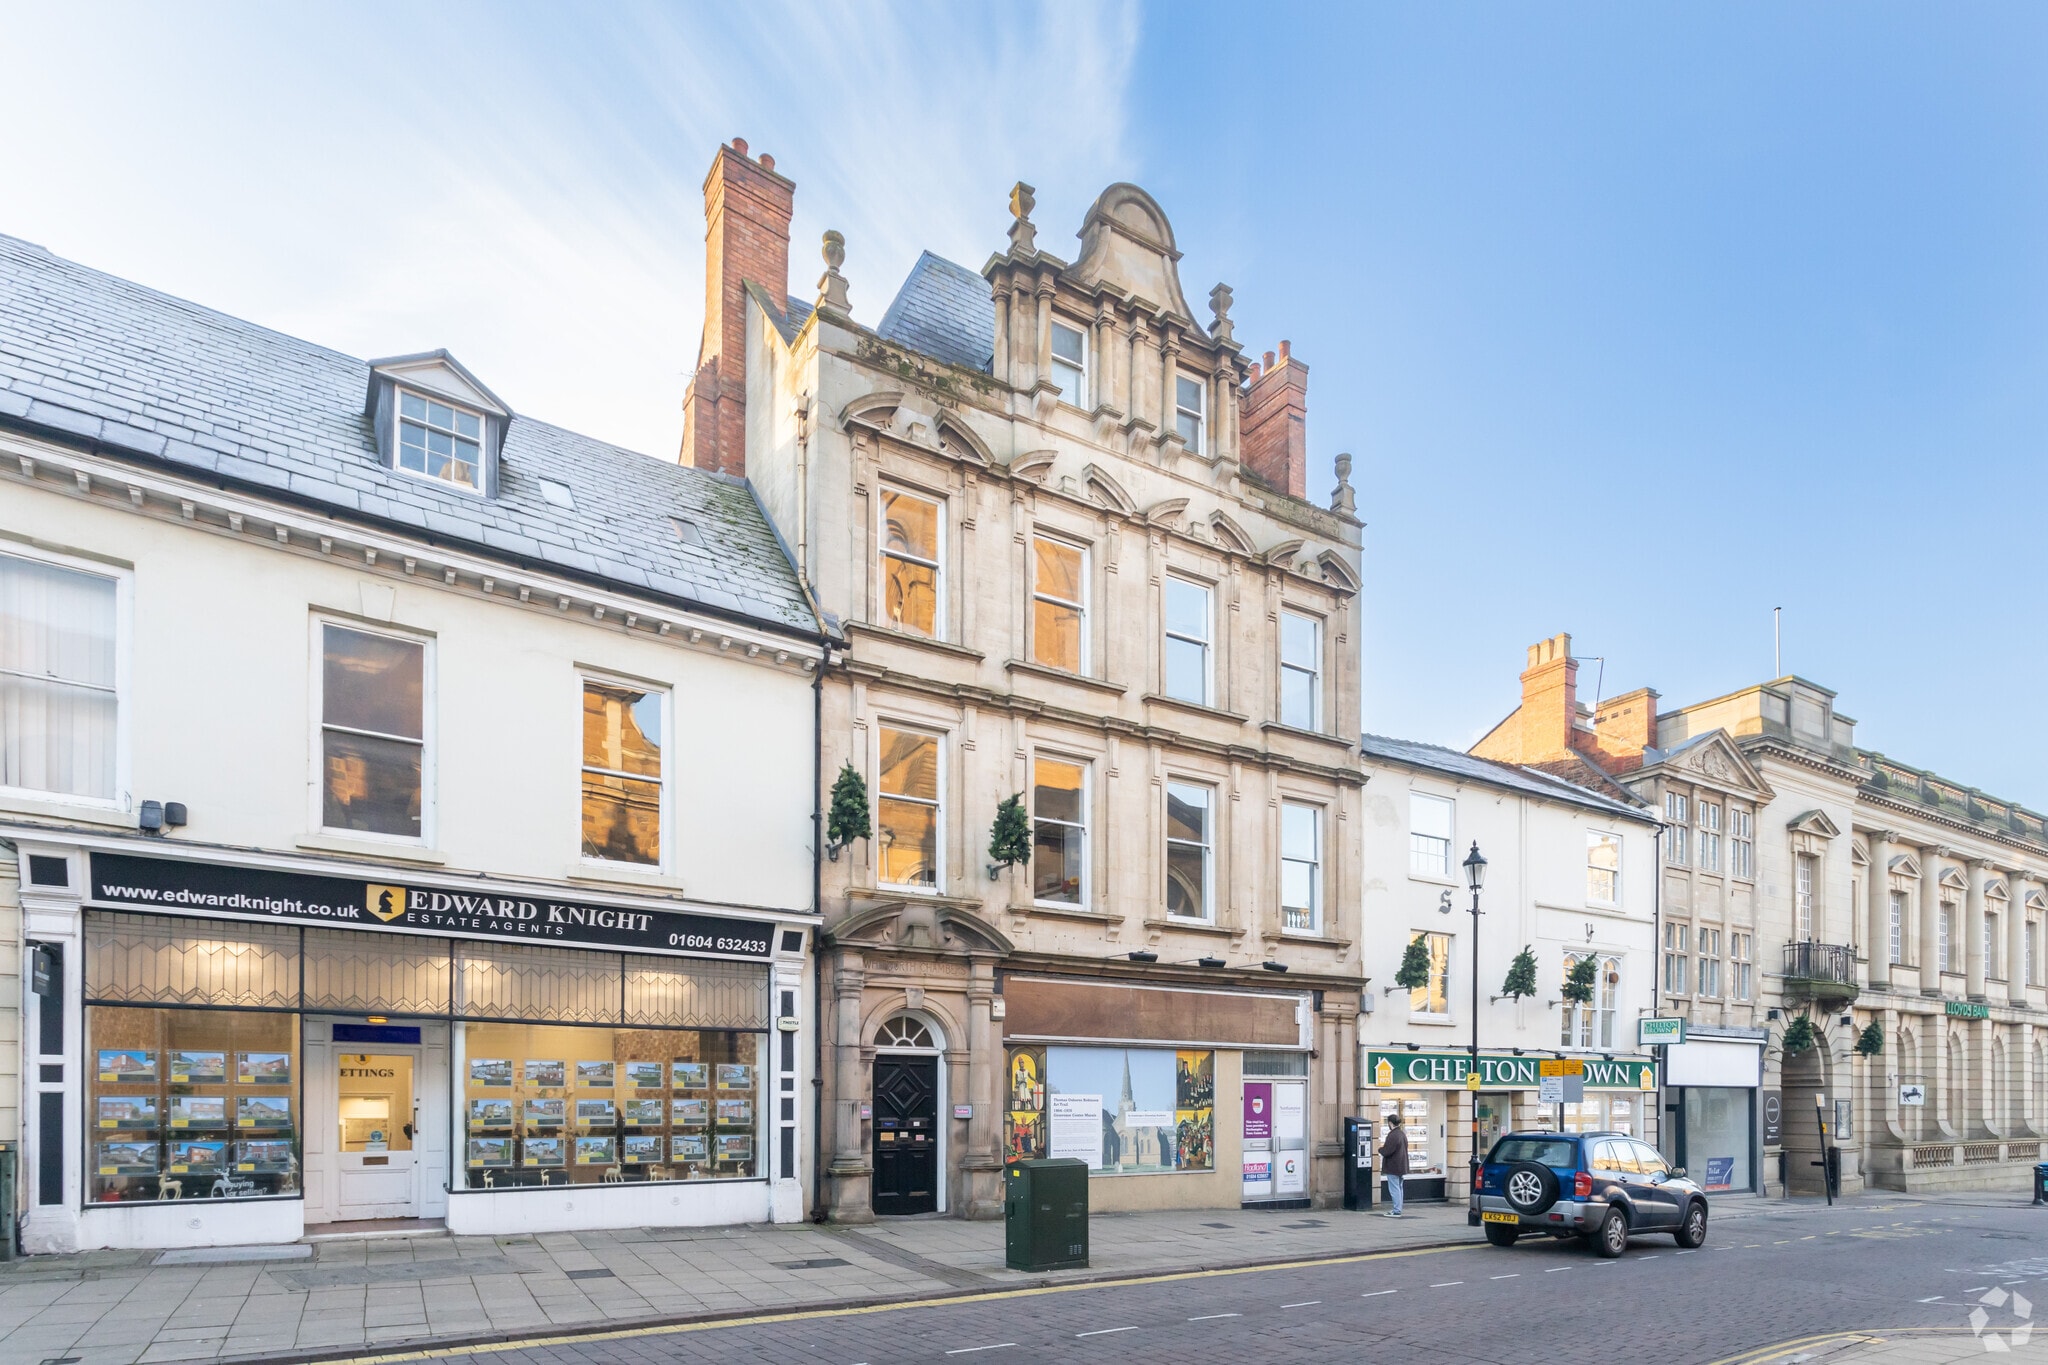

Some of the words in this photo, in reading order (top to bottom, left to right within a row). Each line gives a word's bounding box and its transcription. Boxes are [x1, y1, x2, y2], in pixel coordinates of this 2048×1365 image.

[102, 884, 360, 918] www.edwardknight.co.uk
[408, 889, 537, 920] EDWARD
[547, 904, 653, 932] KNIGHT
[407, 912, 480, 928] ESTATE
[489, 920, 564, 935] AGENTS
[669, 933, 713, 948] 01604
[717, 937, 767, 953] 632433
[1947, 1002, 1972, 1016] LLOYDS
[1972, 1005, 1989, 1018] BANK
[340, 1068, 394, 1077] ETTINGS
[1583, 1063, 1631, 1084] OWN
